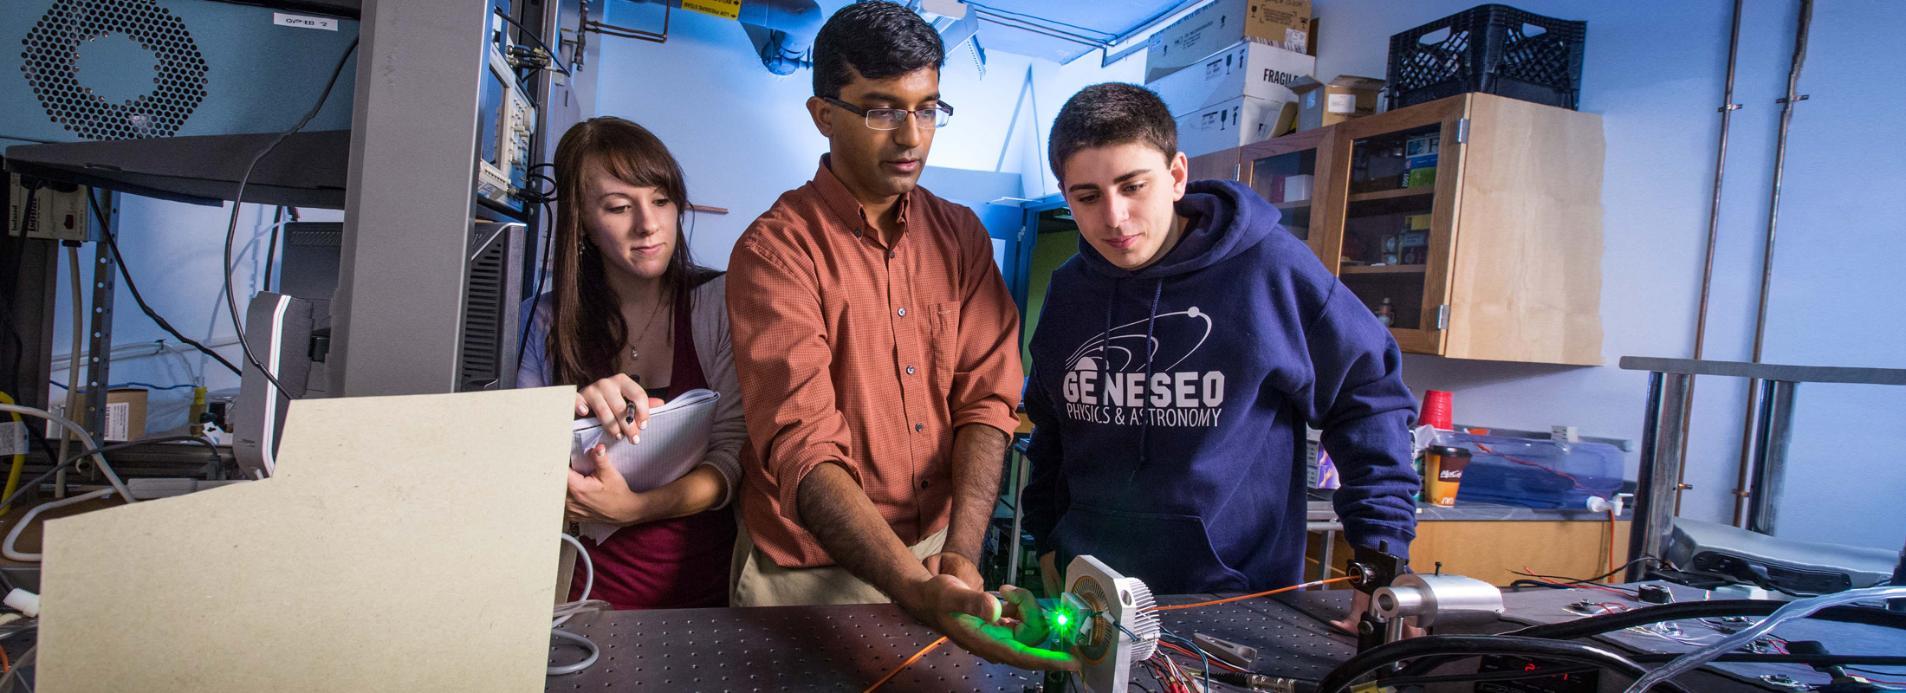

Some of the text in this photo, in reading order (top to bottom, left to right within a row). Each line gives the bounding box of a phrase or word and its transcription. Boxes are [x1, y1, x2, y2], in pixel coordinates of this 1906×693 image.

[1063, 371, 1225, 408] GENESEO
[1066, 402, 1111, 424] PHYSICS
[1114, 407, 1125, 425] &
